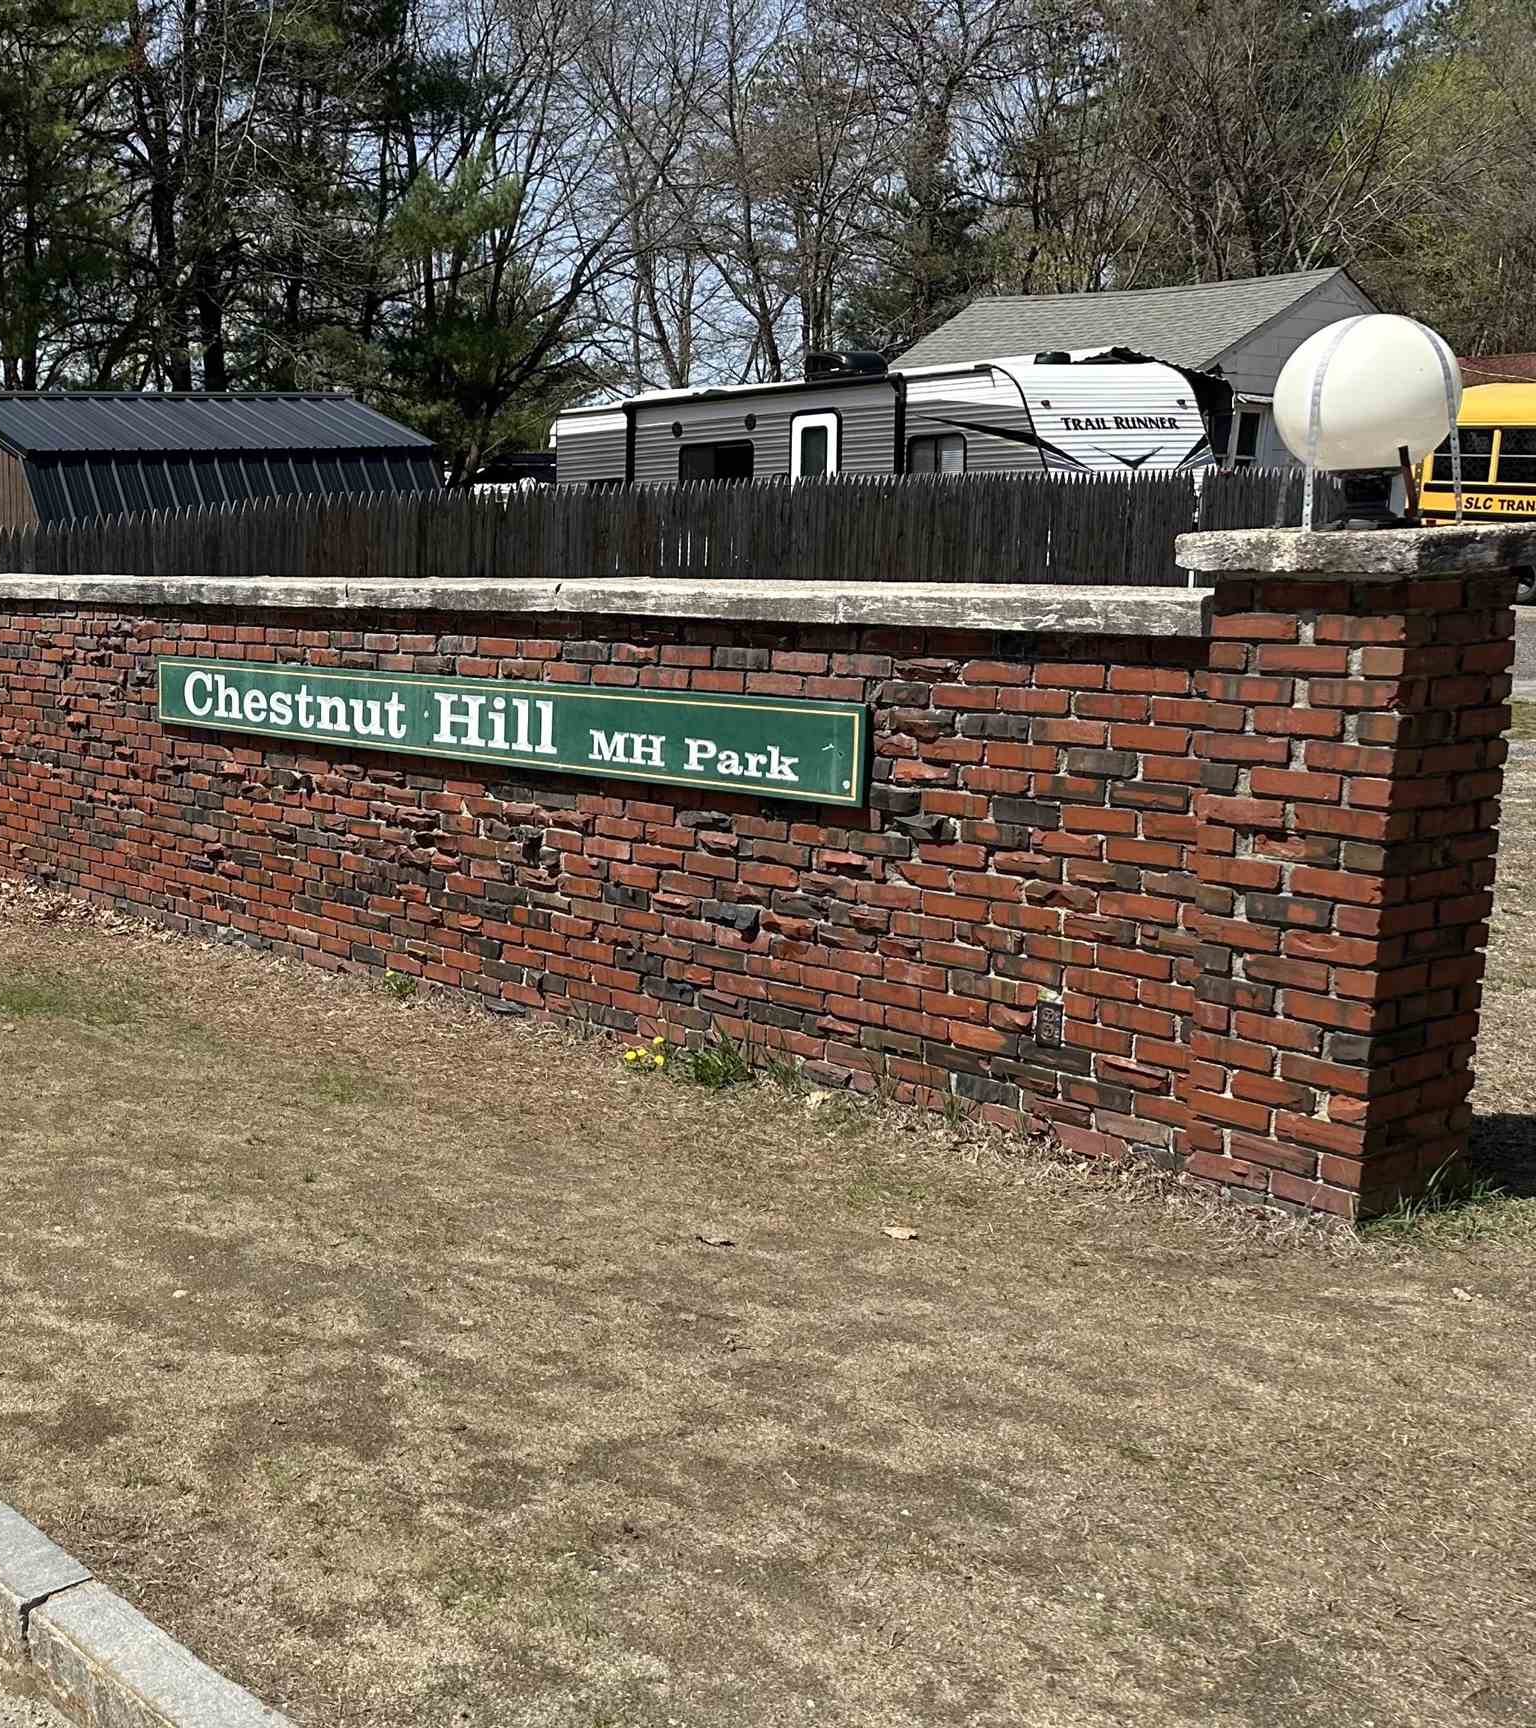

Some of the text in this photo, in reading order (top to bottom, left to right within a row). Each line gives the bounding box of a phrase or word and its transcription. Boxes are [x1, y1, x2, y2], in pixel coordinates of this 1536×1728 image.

[1060, 415, 1181, 431] TRAIL RUNNER
[1464, 496, 1493, 510] SLC
[183, 670, 800, 782] Chestnut Hill MH Park
